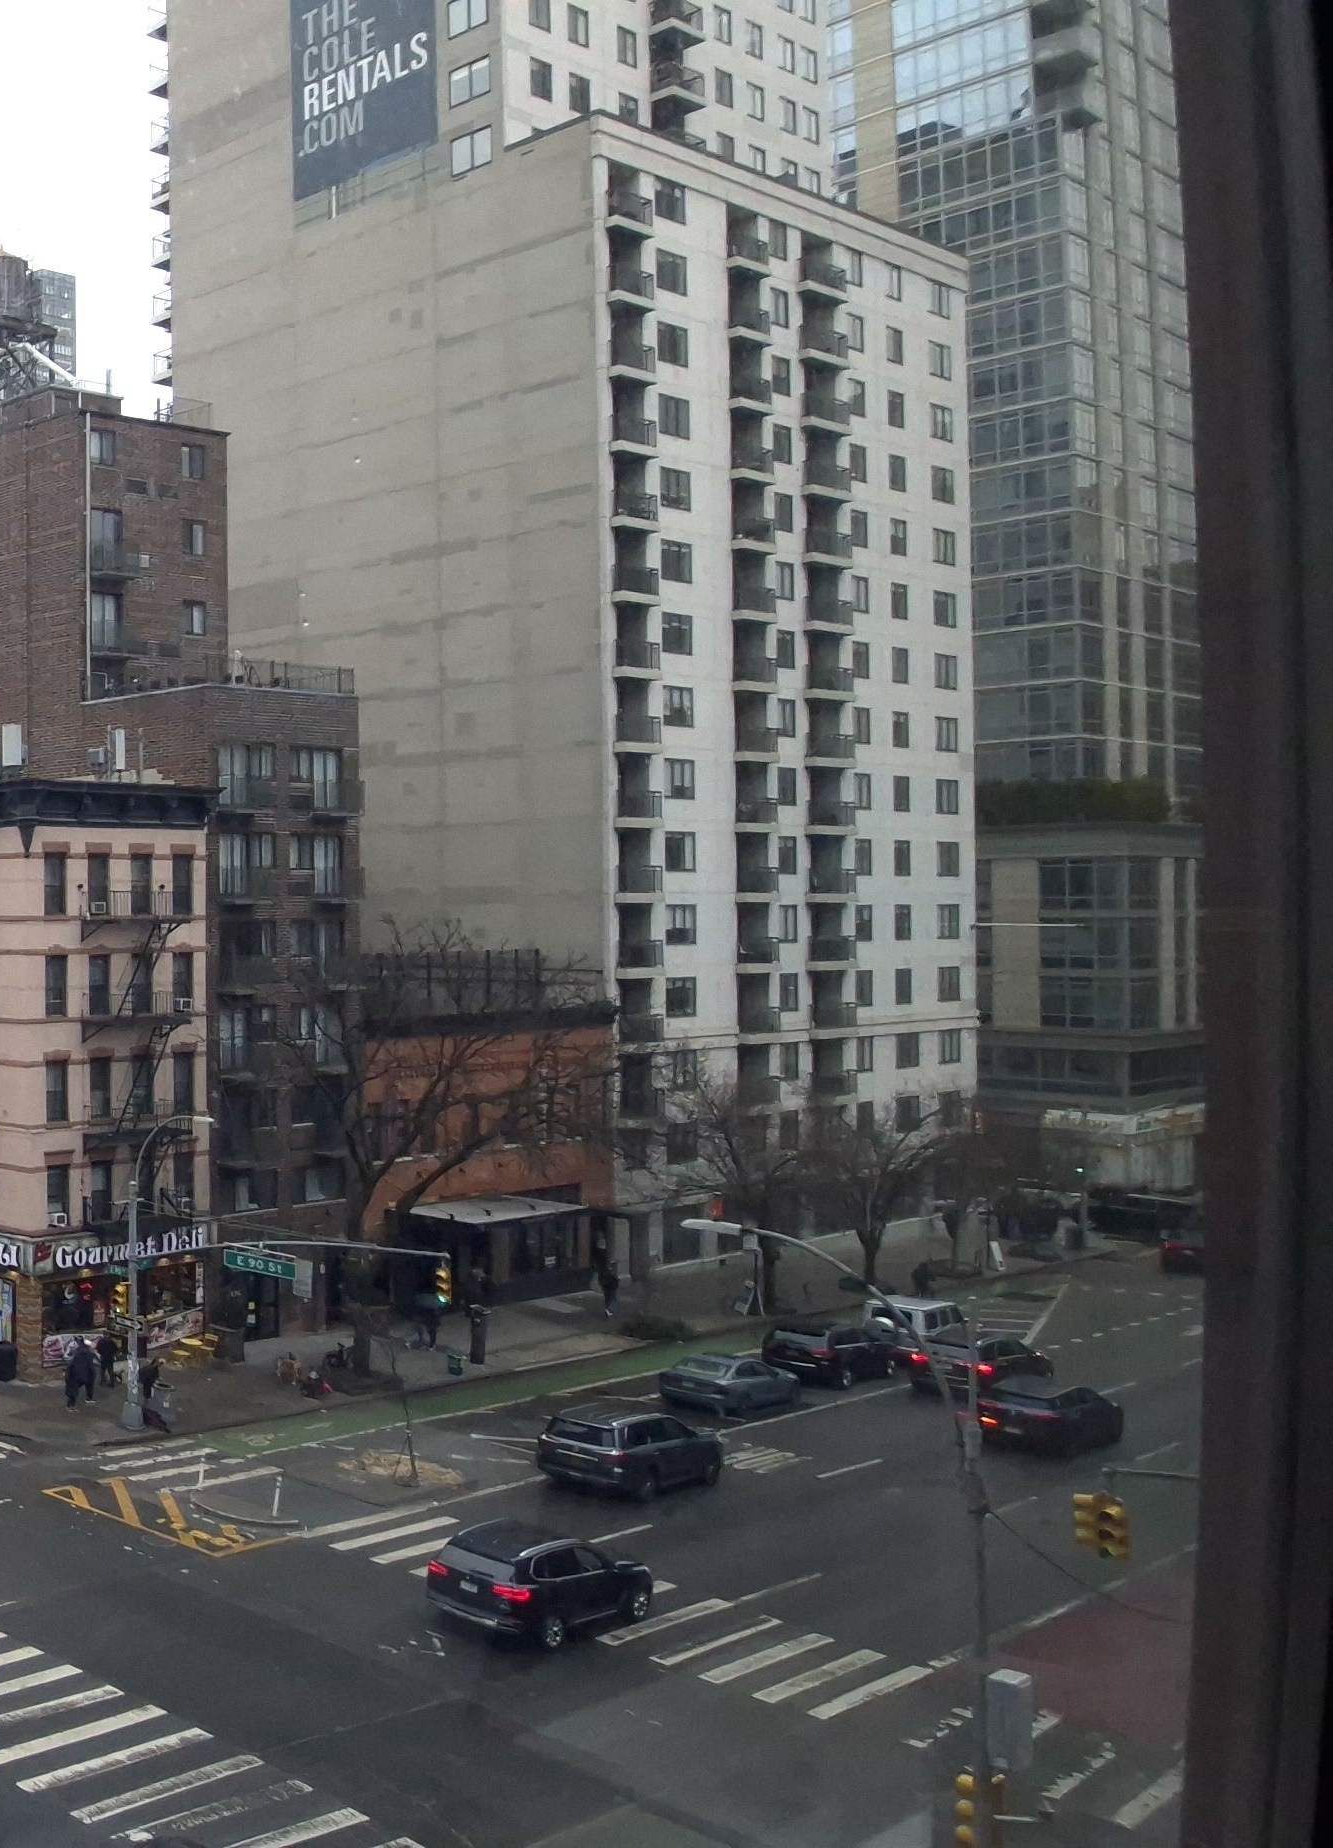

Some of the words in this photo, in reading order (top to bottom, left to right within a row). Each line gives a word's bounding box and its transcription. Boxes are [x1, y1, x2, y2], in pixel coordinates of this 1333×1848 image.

[301, 0, 358, 45] THE
[302, 16, 376, 82] COLE
[303, 31, 428, 121] RENTALS
[298, 99, 364, 157] .COM
[55, 1235, 158, 1269] Gourmet
[162, 1226, 204, 1253] Deli
[236, 1256, 245, 1266] E
[248, 1258, 264, 1270] 90
[268, 1262, 283, 1274] St
